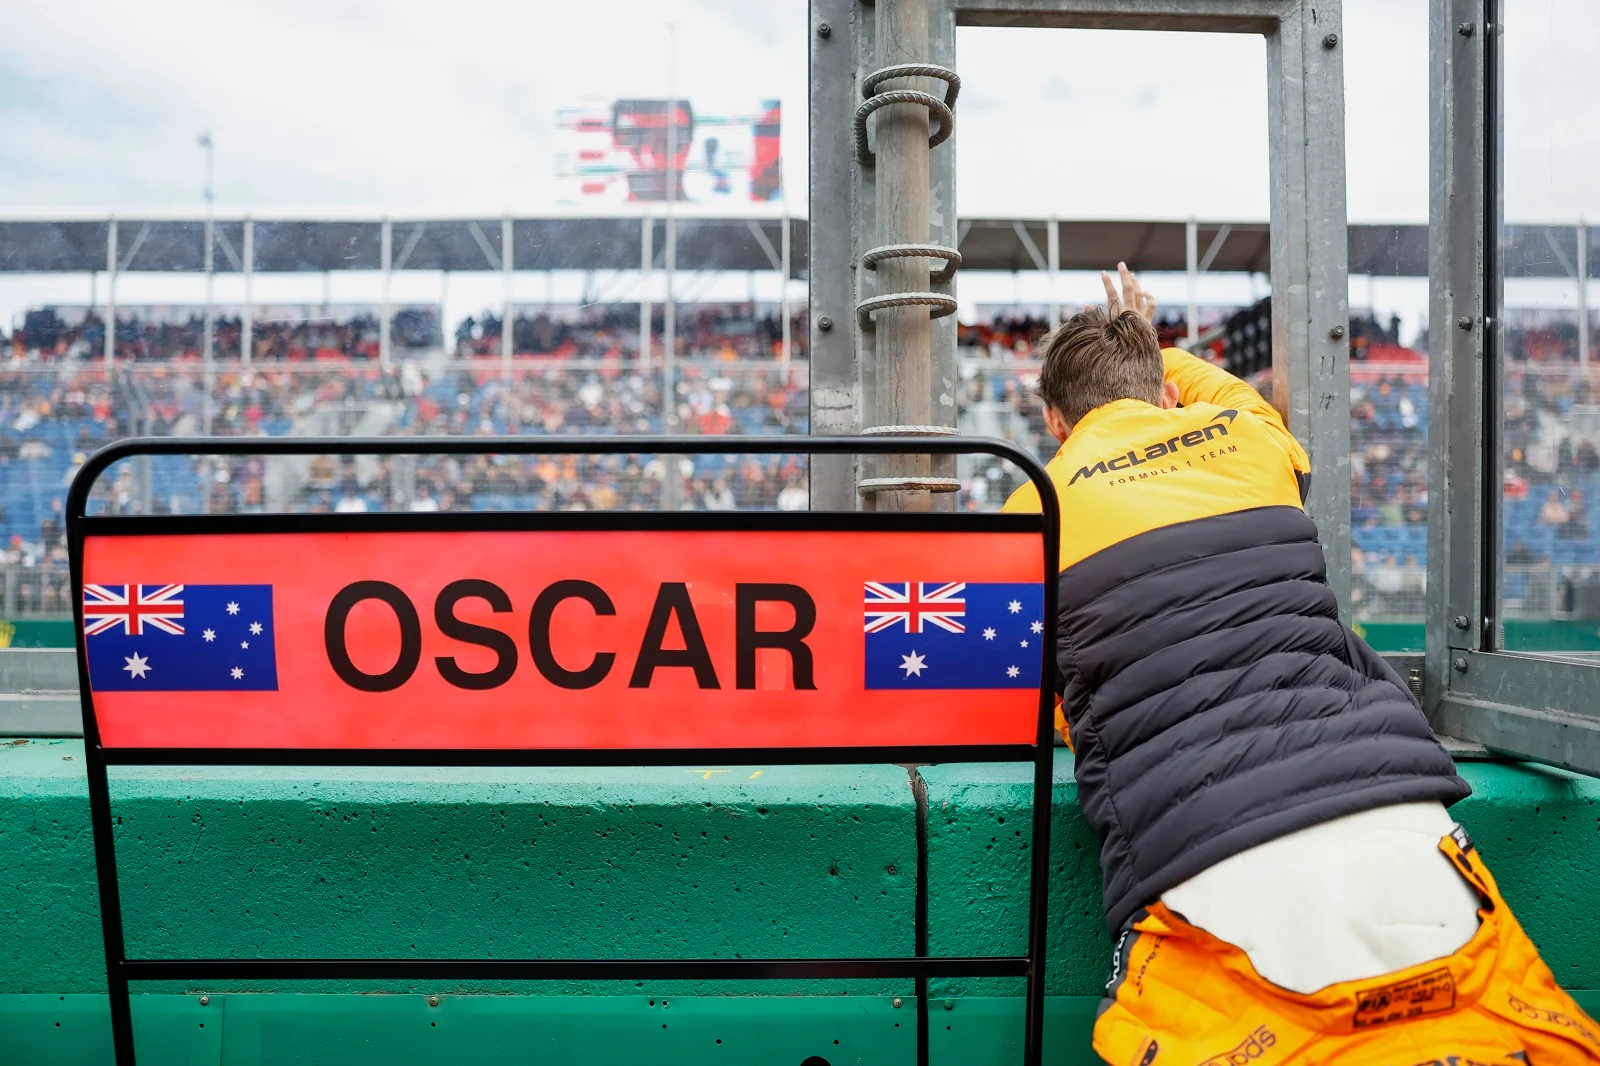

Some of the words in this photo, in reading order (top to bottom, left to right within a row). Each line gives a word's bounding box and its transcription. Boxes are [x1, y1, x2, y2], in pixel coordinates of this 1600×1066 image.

[1066, 423, 1229, 487] McLaren
[1109, 465, 1178, 487] FORMULA
[1185, 460, 1193, 468] 1
[1199, 445, 1238, 462] TEAM
[324, 579, 817, 693] OSCAR
